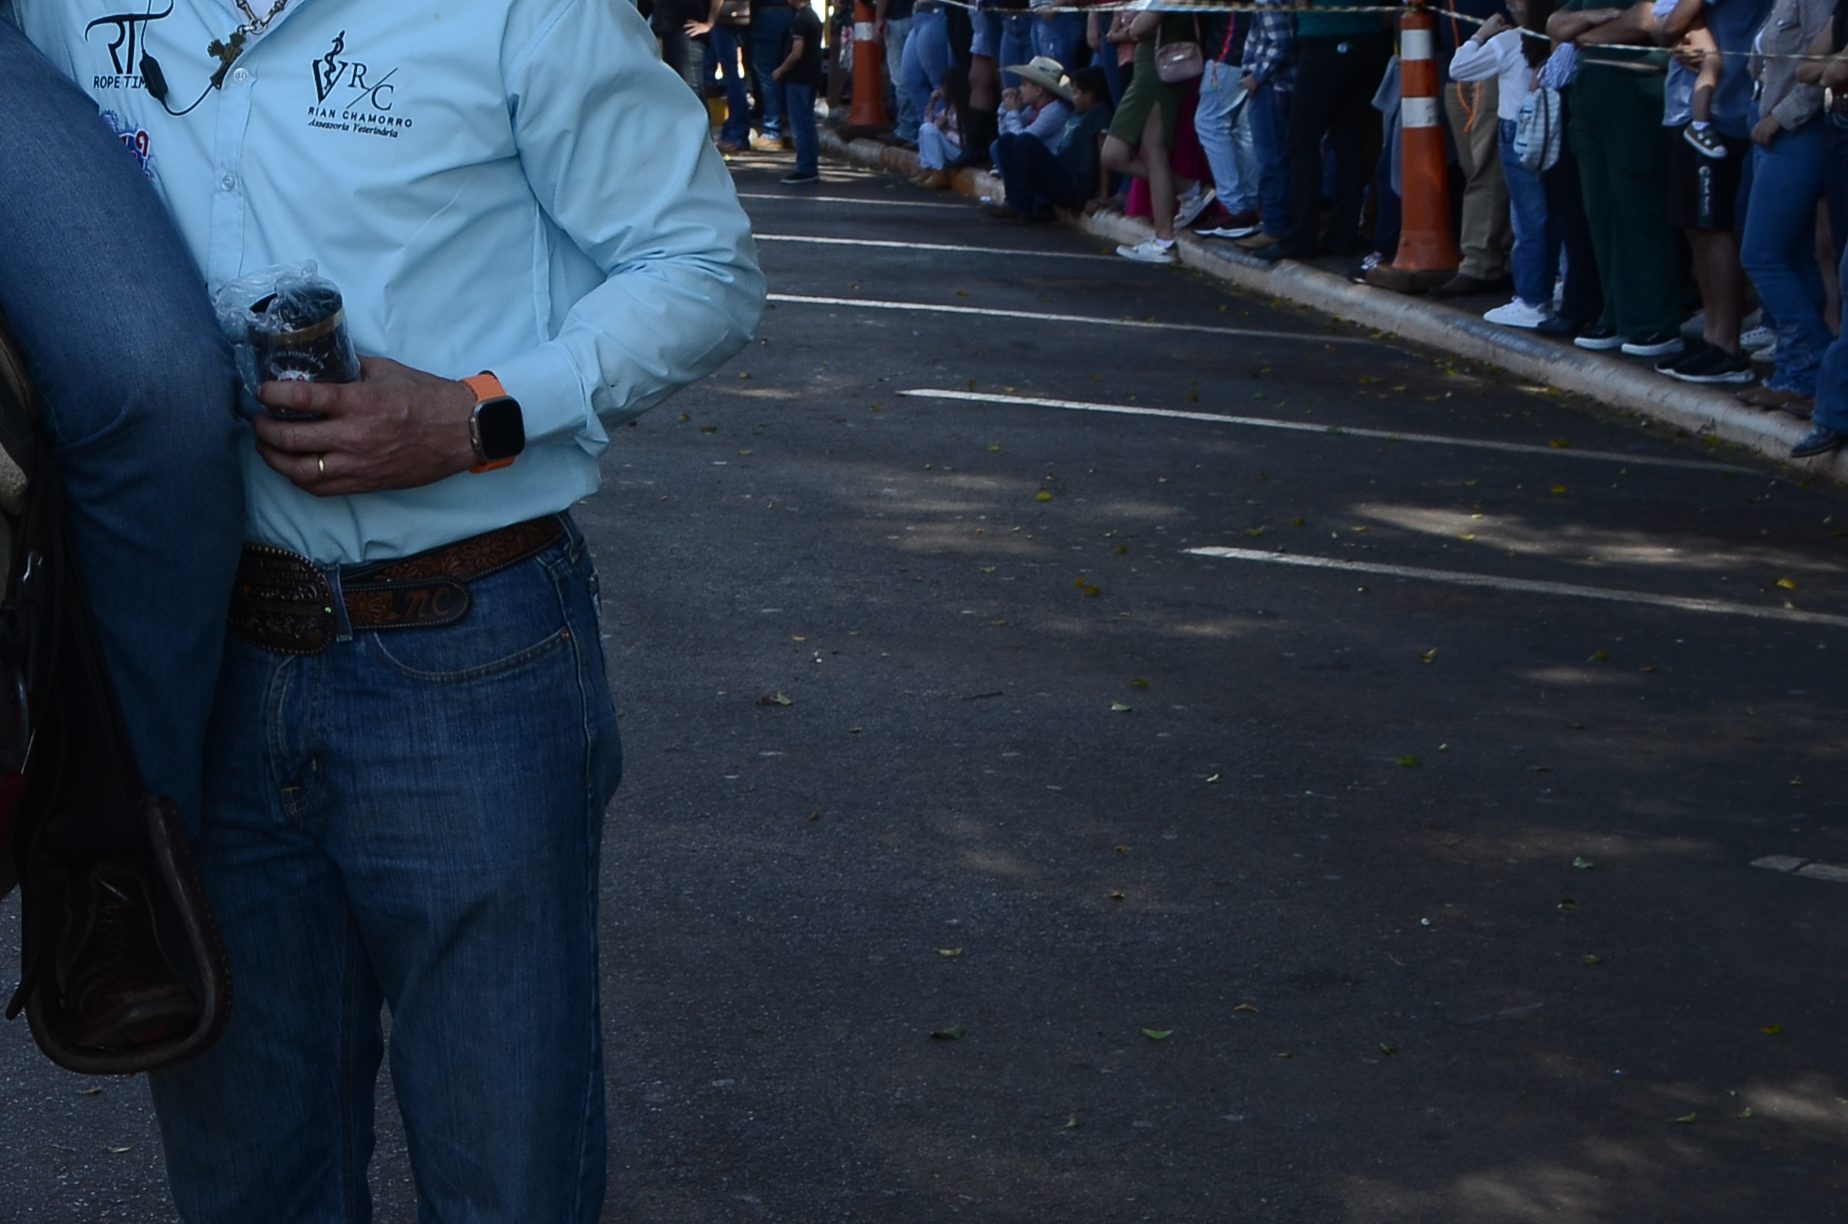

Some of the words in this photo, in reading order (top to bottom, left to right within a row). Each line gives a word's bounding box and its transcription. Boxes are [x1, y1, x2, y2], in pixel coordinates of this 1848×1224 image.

[93, 76, 120, 89] ROPE
[123, 76, 148, 90] TIM
[308, 106, 336, 119] RIAN
[342, 110, 413, 128] CHAMORRO
[308, 118, 350, 132] Assessoria
[353, 123, 399, 138] Veterinária
